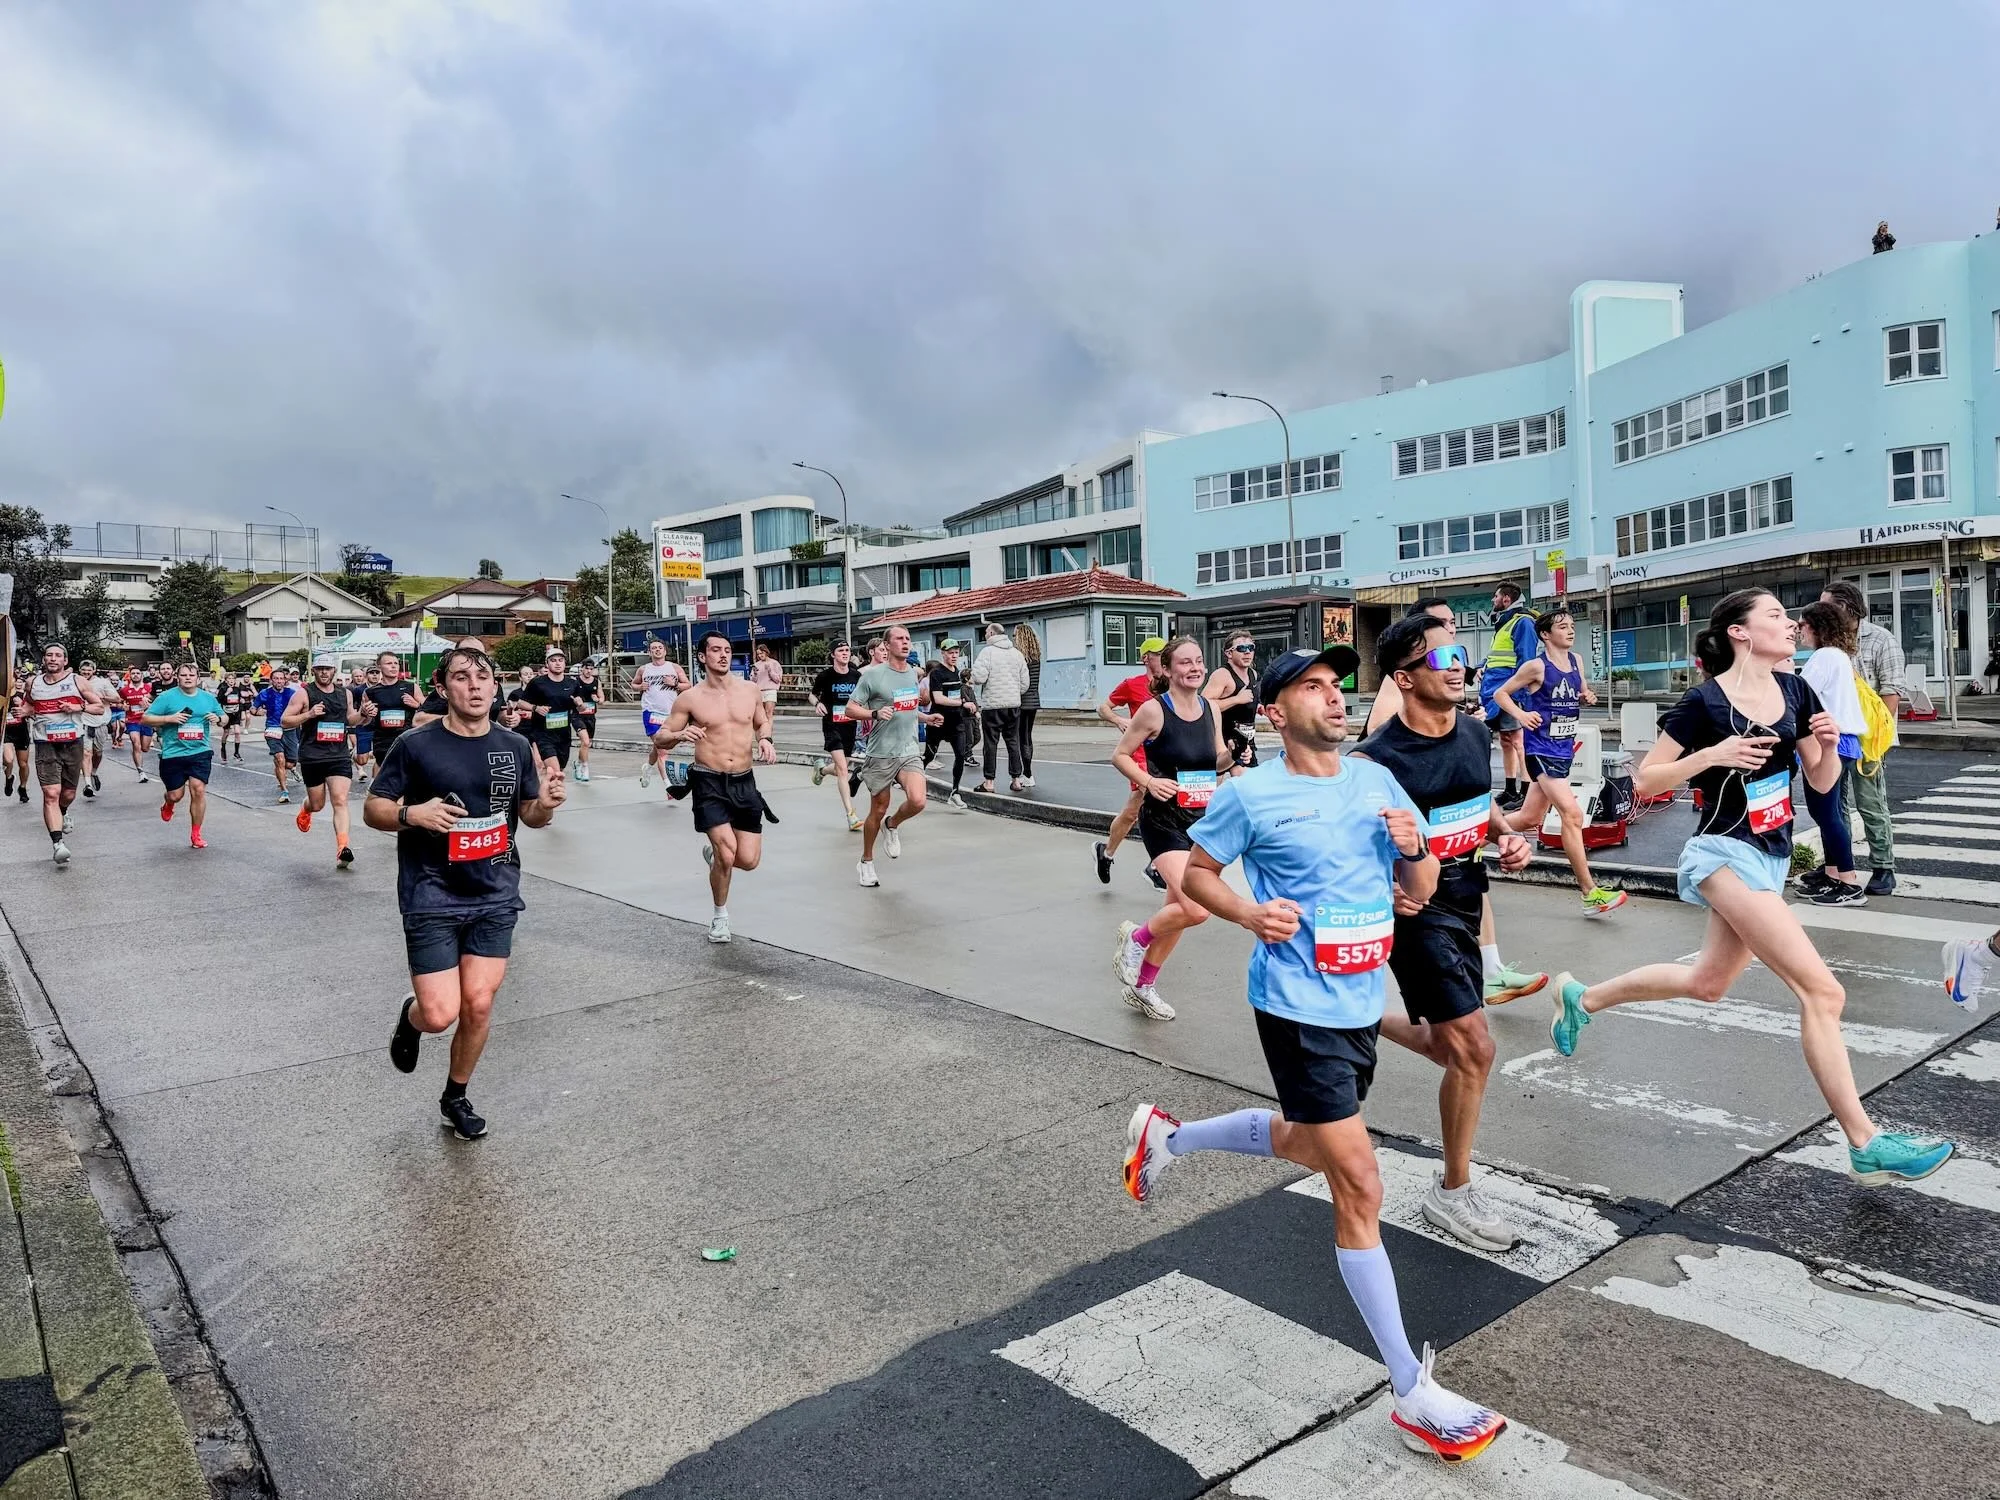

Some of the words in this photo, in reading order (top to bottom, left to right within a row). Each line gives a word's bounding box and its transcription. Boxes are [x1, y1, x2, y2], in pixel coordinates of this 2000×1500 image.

[1859, 520, 1975, 544] HAIRDRESSING
[371, 563, 387, 571] GOLF
[1389, 566, 1450, 583] CHEMIST
[1610, 564, 1649, 580] UNDRY
[1187, 791, 1211, 802] 2935
[487, 751, 517, 866] EVERT
[1440, 803, 1484, 822] CITY2SURF
[456, 816, 502, 829] CITY2SURF
[459, 830, 501, 850] 5483
[1444, 827, 1479, 851] 7775
[1330, 909, 1388, 926] CITY2SURF
[1336, 941, 1384, 965] 5579
